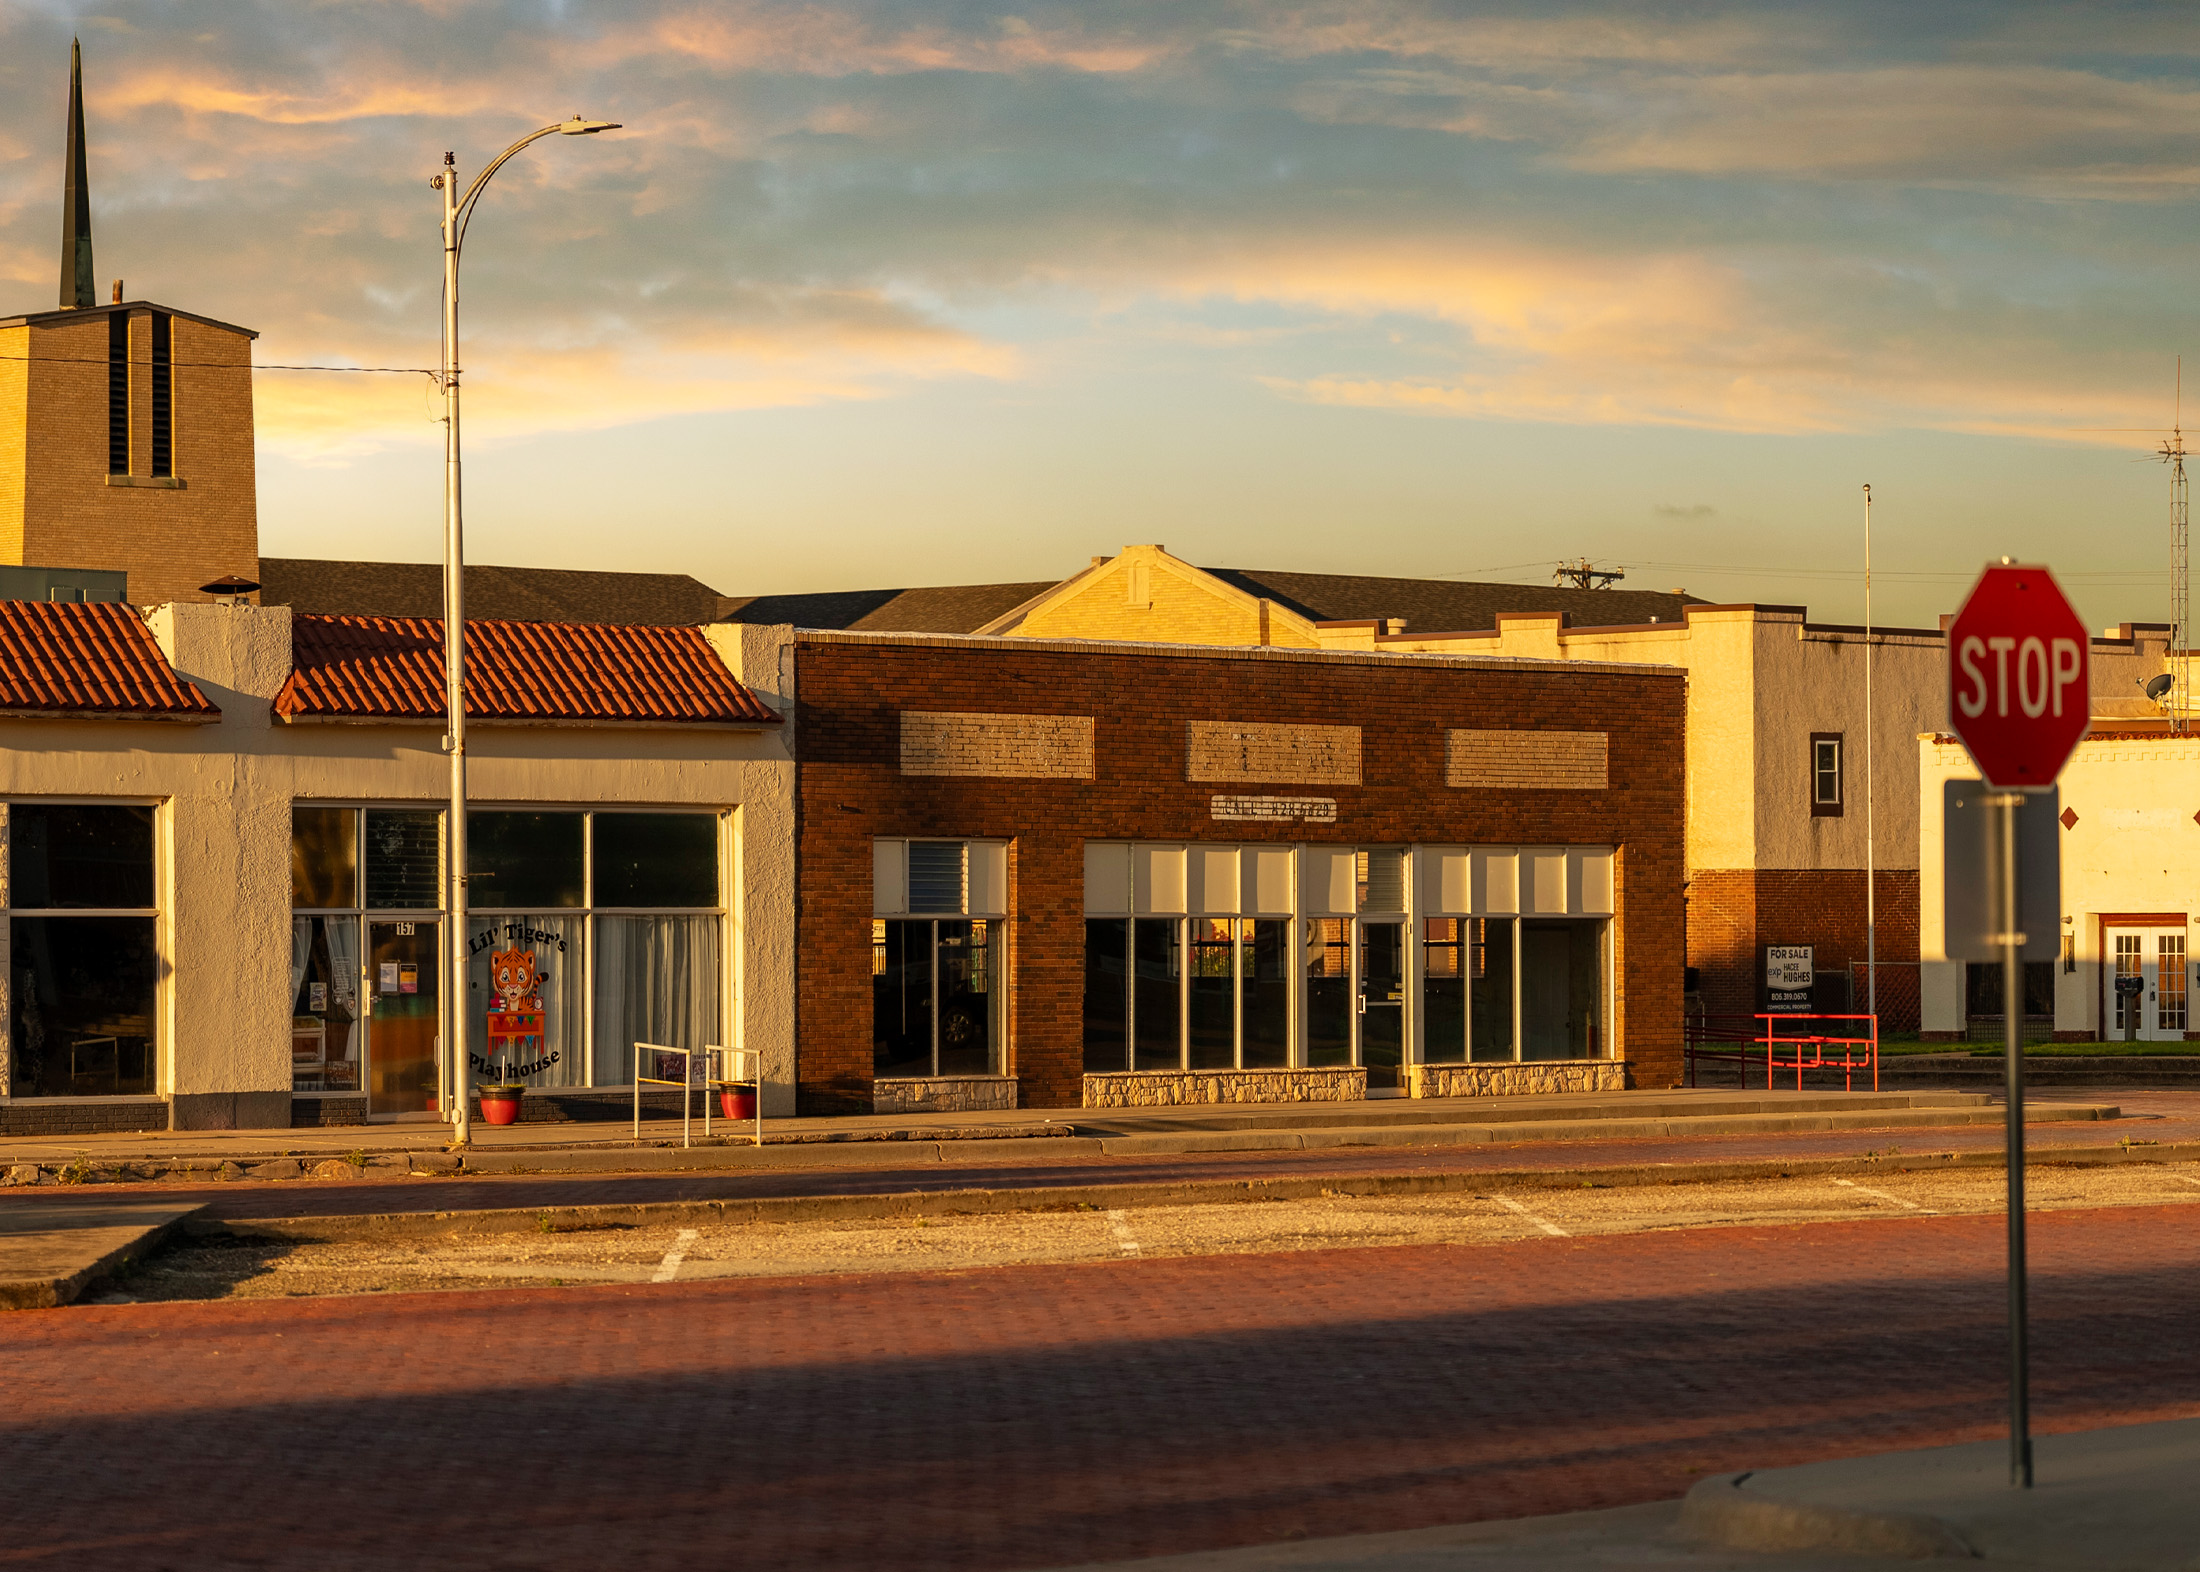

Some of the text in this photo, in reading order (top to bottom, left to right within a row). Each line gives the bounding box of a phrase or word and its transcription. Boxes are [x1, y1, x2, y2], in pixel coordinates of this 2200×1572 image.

[1957, 635, 2081, 719] STOP
[397, 922, 414, 933] 157
[468, 923, 567, 955] Lil' Tiger's
[1770, 949, 1809, 959] FOR SALE
[1783, 971, 1811, 983] HUGHES
[468, 1050, 560, 1081] Playhouse
